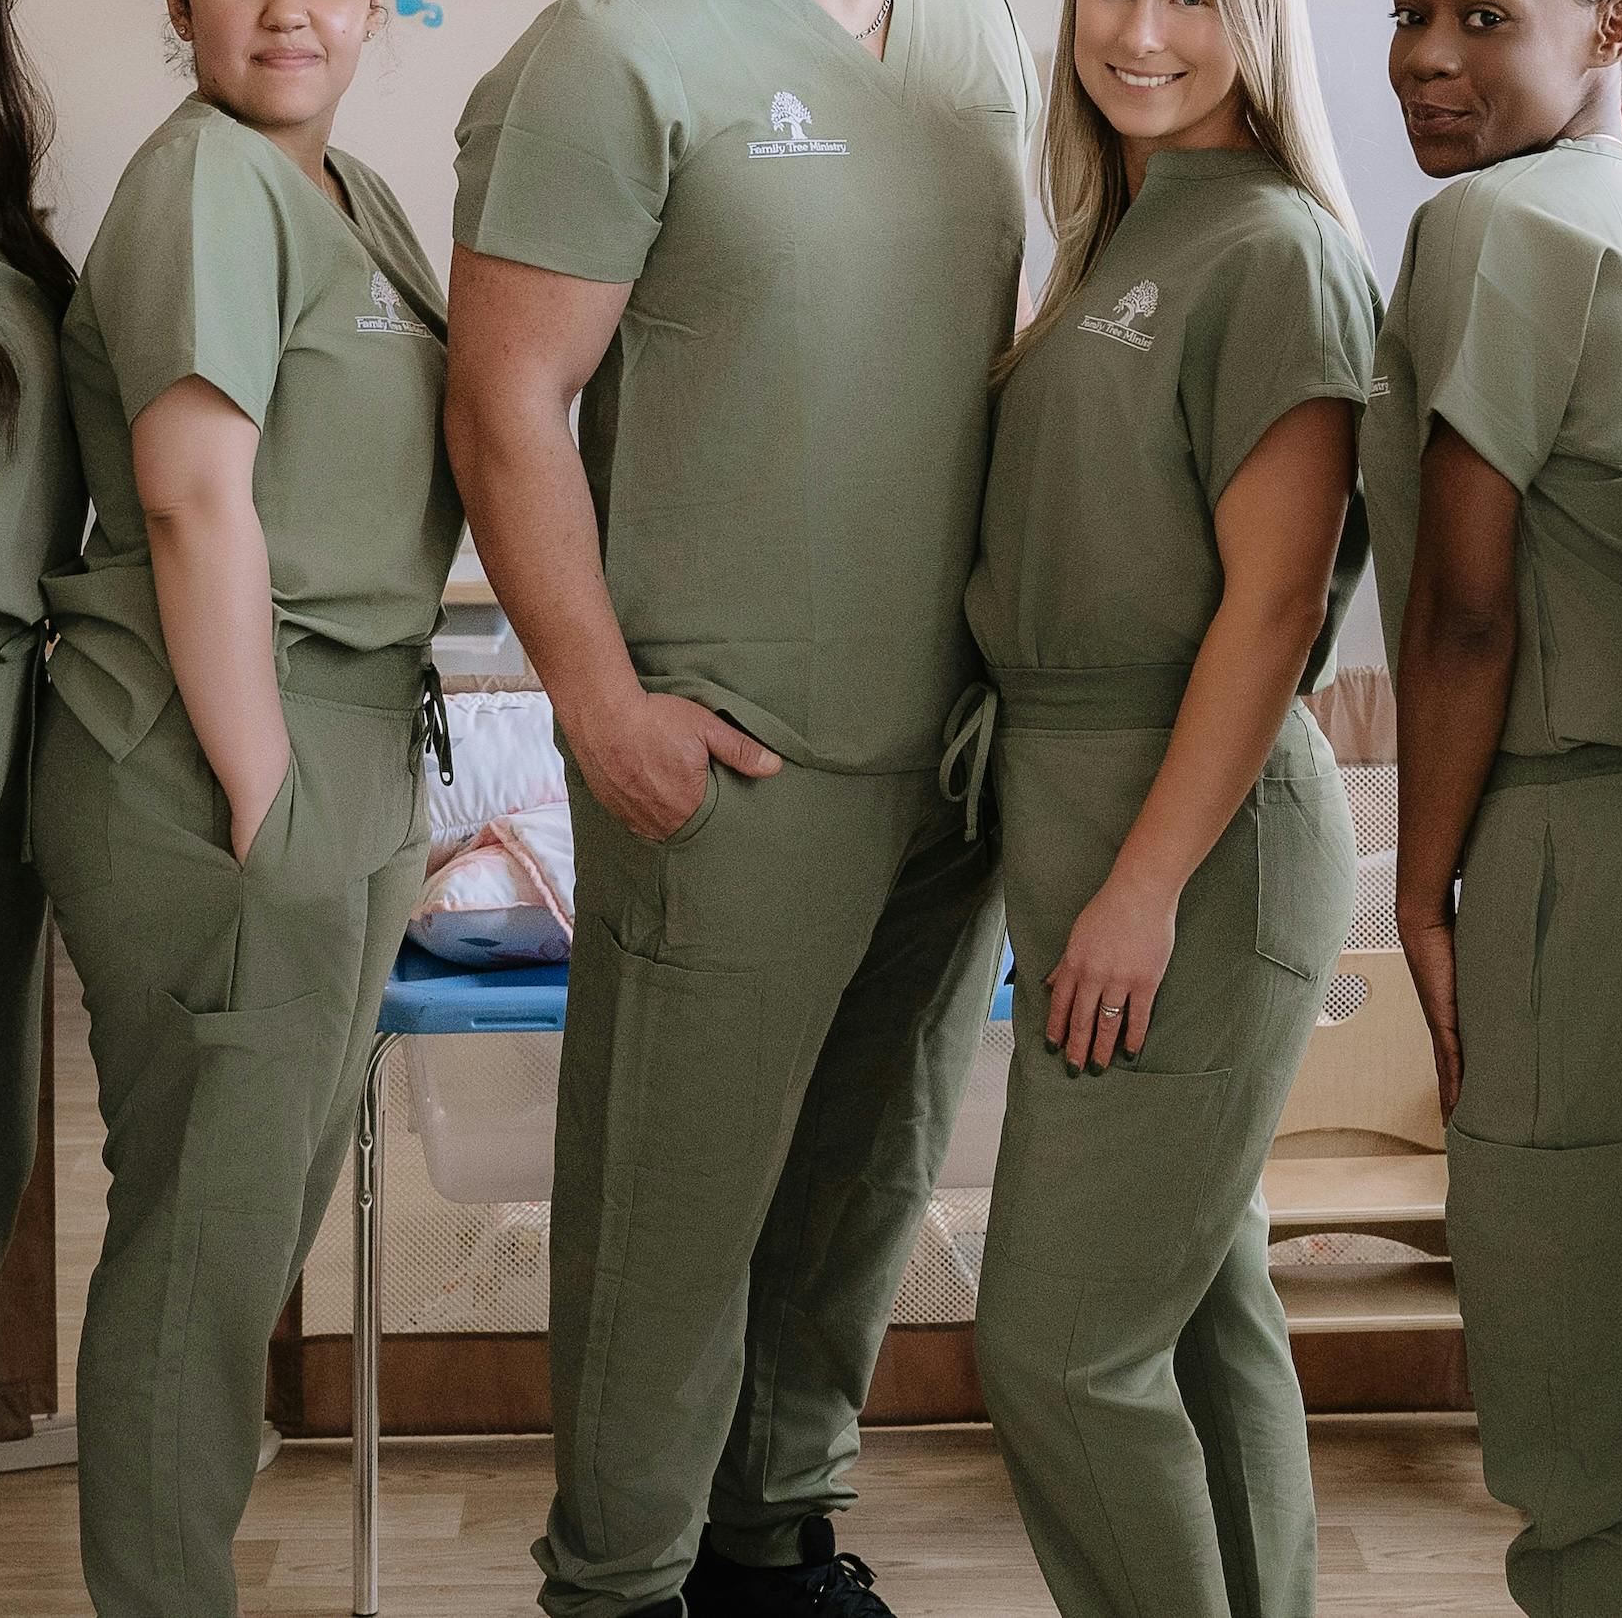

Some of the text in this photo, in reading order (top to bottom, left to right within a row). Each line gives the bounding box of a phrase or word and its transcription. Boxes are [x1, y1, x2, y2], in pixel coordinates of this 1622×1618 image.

[749, 141, 847, 156] Family Tree Ministry
[356, 318, 388, 331] Family
[1105, 324, 1123, 337] Tree
